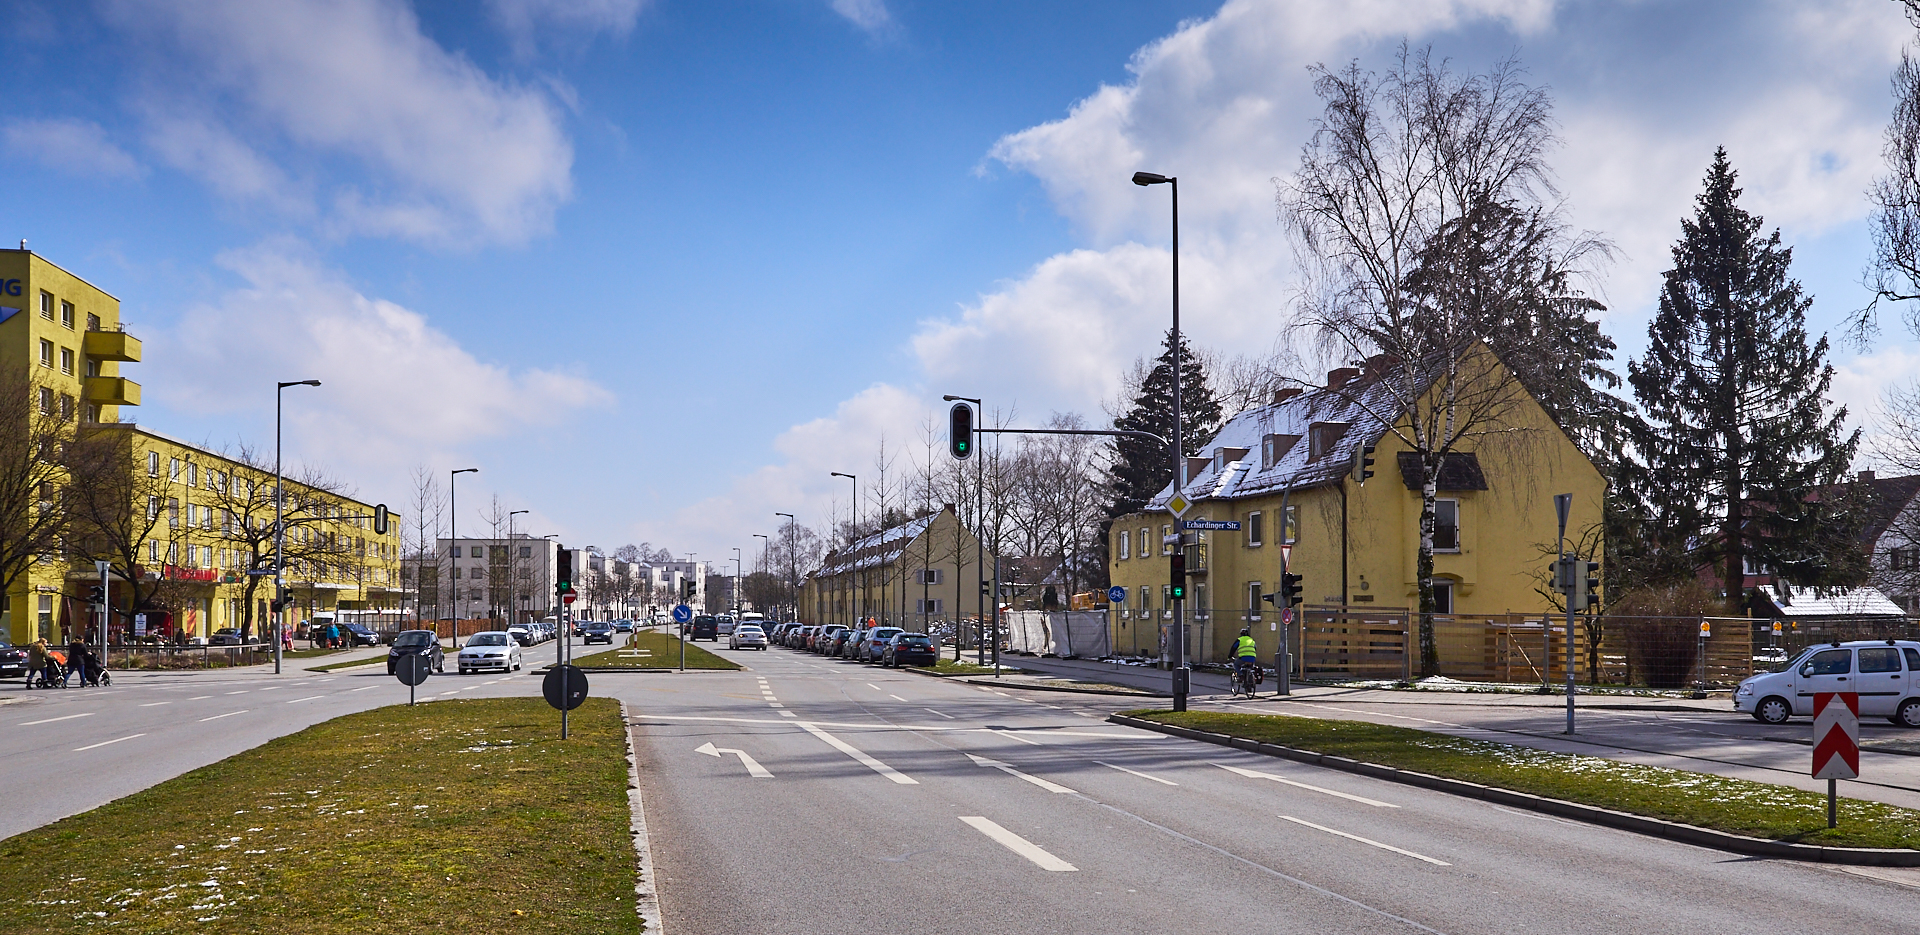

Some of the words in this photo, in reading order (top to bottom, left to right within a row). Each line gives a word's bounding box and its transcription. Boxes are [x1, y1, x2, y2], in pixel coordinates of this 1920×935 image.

[0, 278, 21, 296] G
[1186, 521, 1225, 530] Echardinger
[1226, 521, 1238, 530] Str.
